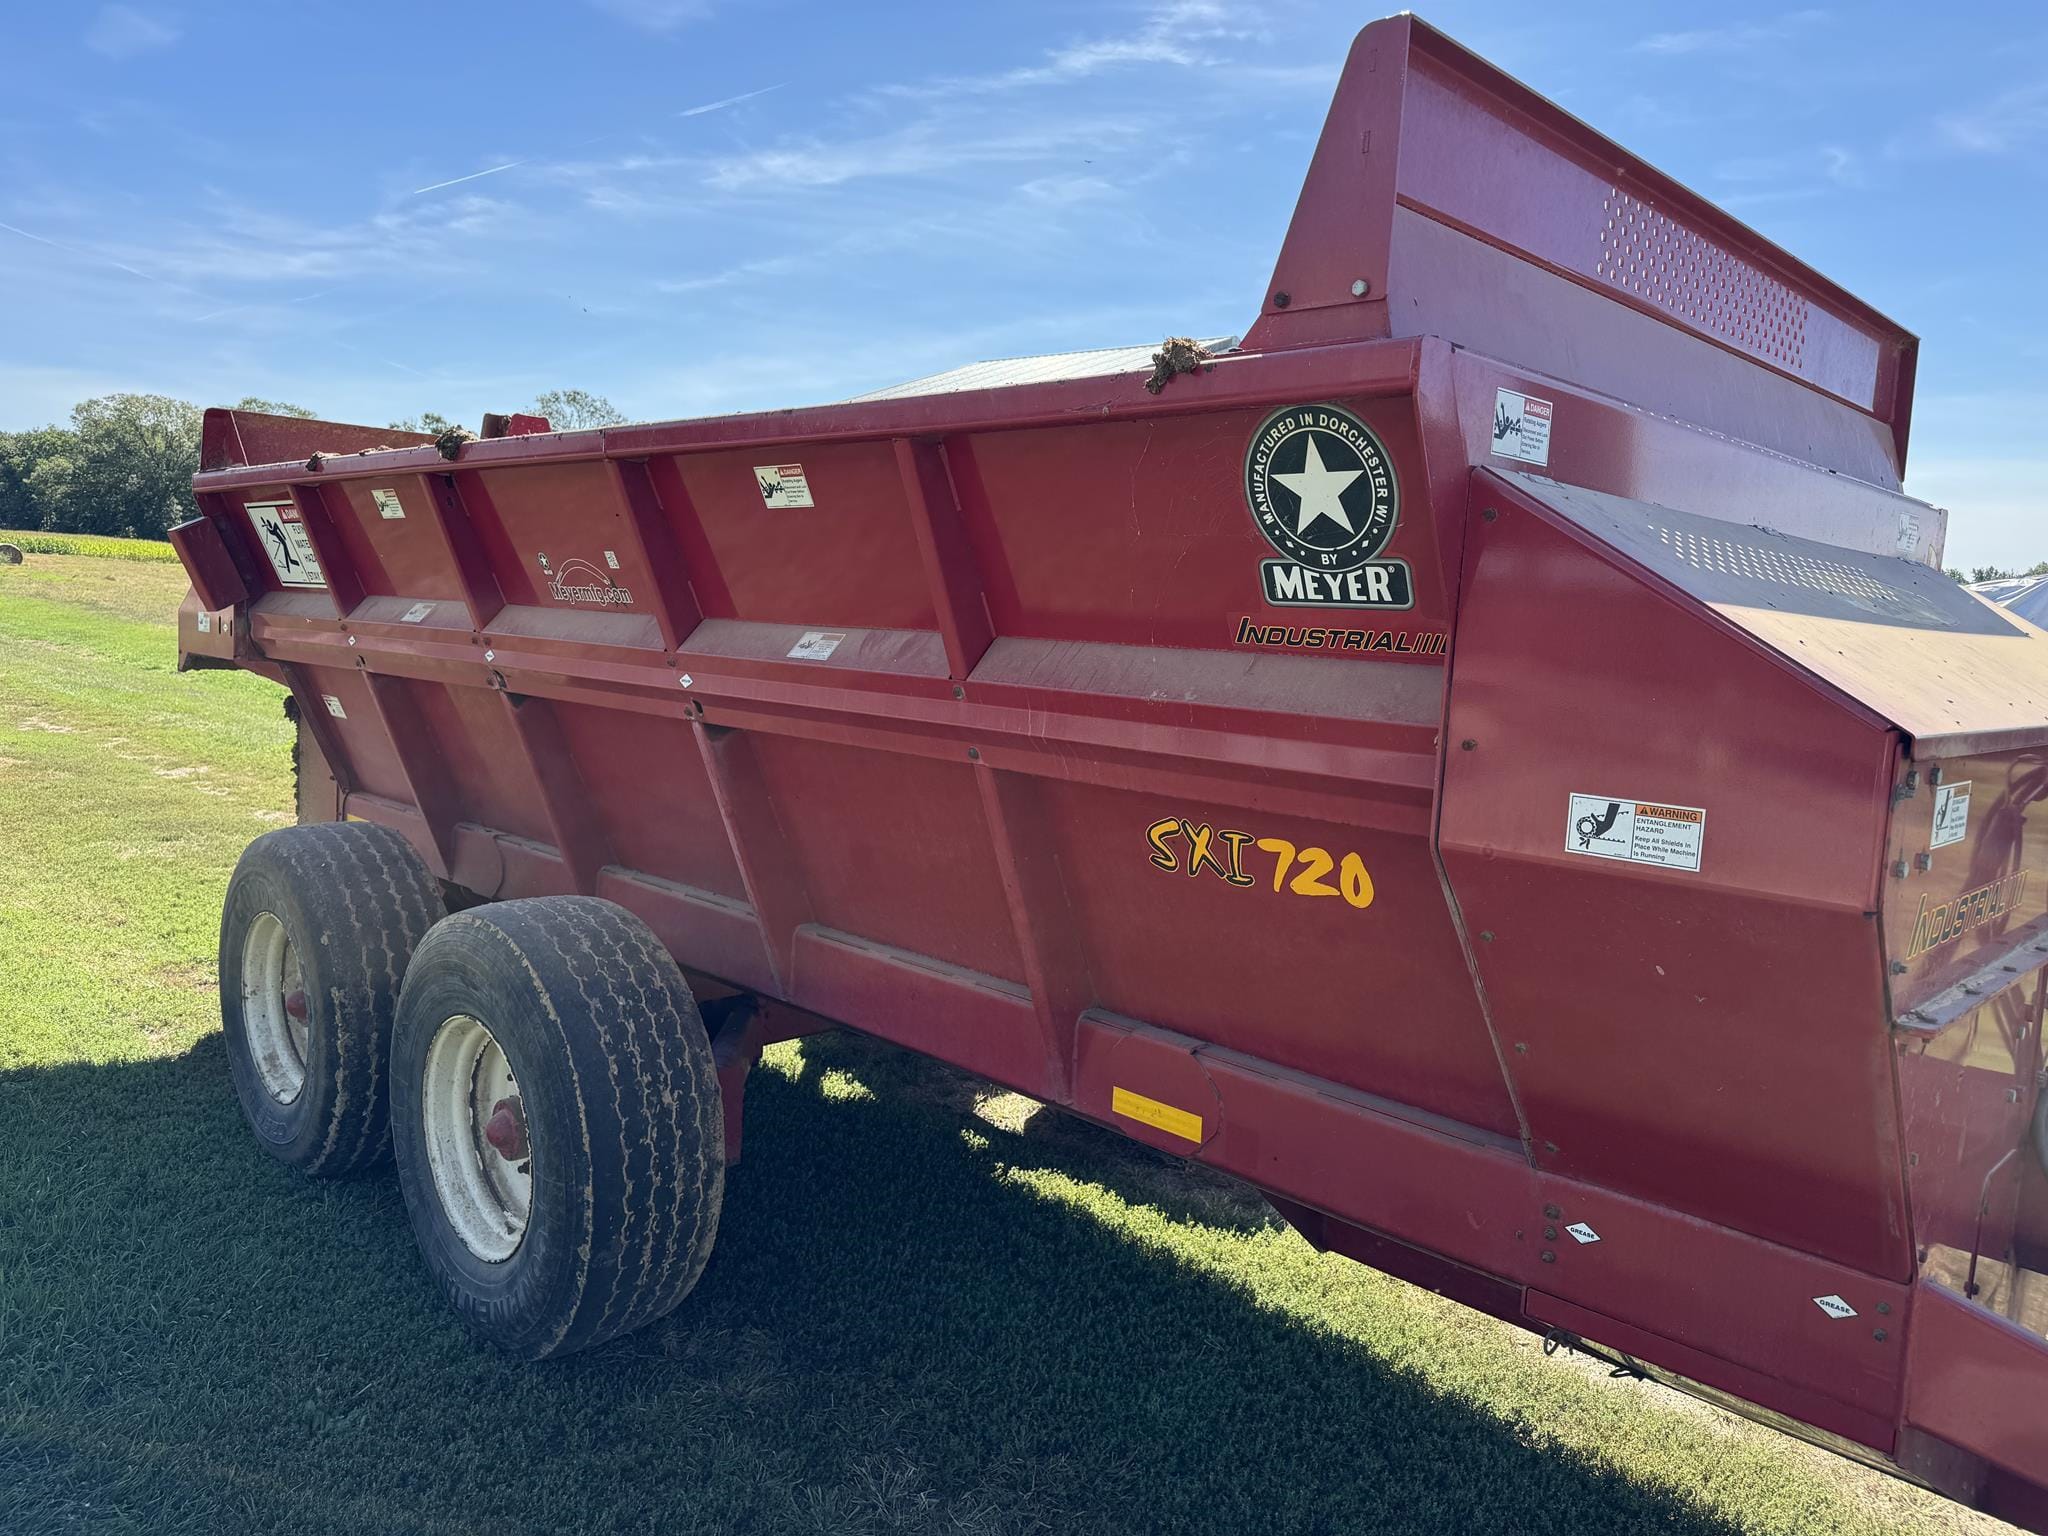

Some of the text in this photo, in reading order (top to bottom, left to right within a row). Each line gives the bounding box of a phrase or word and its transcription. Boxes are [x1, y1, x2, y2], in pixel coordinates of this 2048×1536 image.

[1253, 413, 1389, 526] MANUFACTURED IN DORCHESTER WI
[1320, 553, 1338, 565] BY
[1272, 566, 1394, 602] MEYER
[547, 582, 634, 606] Meyermfg.com
[1649, 806, 1698, 821] WARNING
[1636, 817, 1692, 831] ENTANGLEMENT
[1636, 825, 1665, 835] HAZARD
[1635, 835, 1650, 844] Keep
[1660, 838, 1684, 848] Shields
[1634, 842, 1696, 858] Place While Machine
[1640, 851, 1666, 862] Running
[1256, 838, 1374, 908] 720
[1570, 1227, 1595, 1240] GREASE
[1819, 1299, 1851, 1315] GREASE
